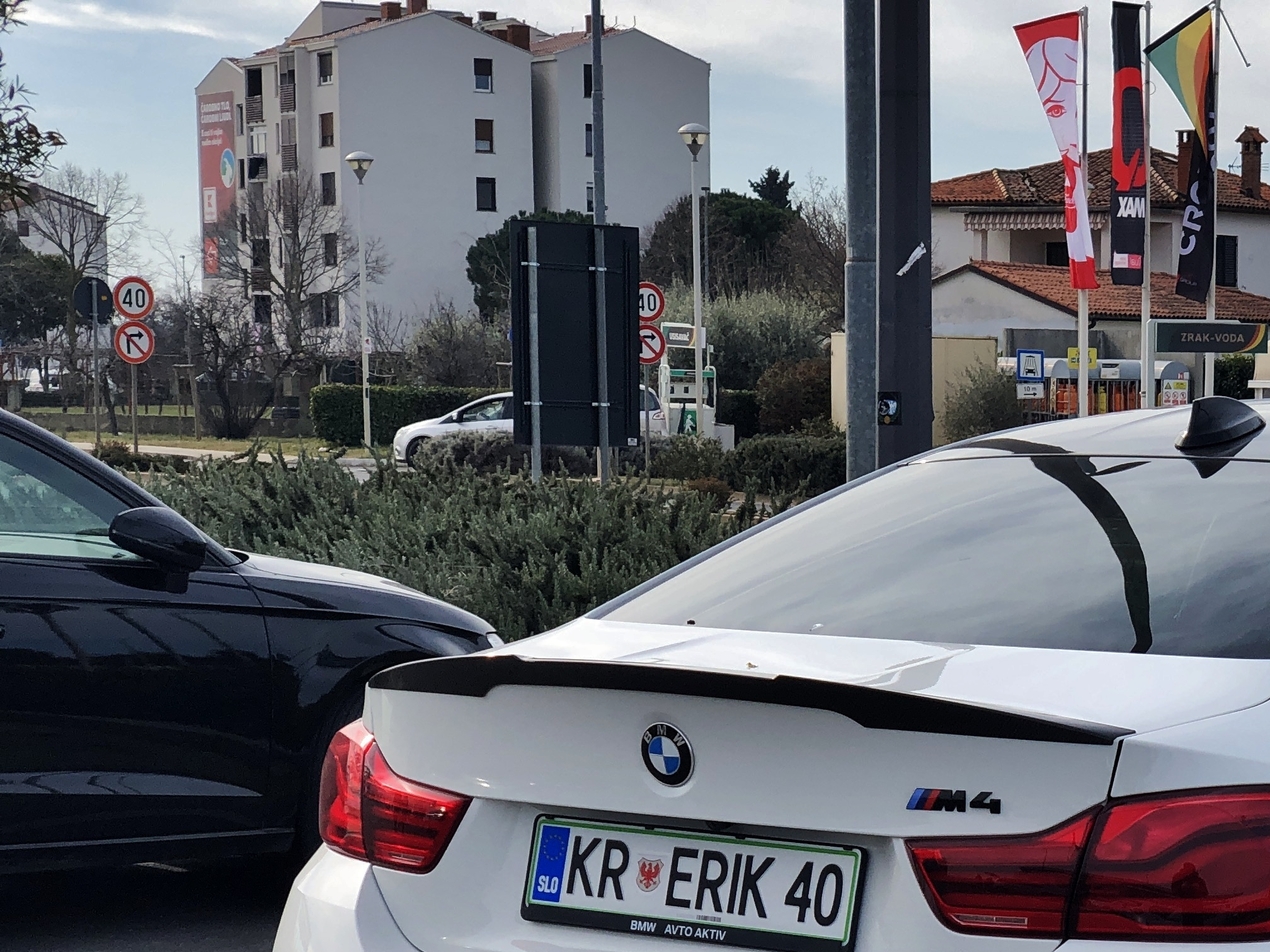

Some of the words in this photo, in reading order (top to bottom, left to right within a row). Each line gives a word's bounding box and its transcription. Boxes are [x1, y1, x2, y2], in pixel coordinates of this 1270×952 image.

[122, 288, 146, 308] 40
[639, 293, 657, 312] 40
[1180, 332, 1245, 343] ZRAK-VODA
[643, 725, 686, 747] BMW
[929, 788, 1002, 815] M4
[537, 875, 559, 894] SLO
[566, 835, 630, 901] KR
[664, 846, 776, 919] ERIK
[784, 861, 844, 927] 40
[630, 920, 657, 933] BMW
[664, 924, 693, 937] AVTO
[694, 927, 727, 941] AKTIV
